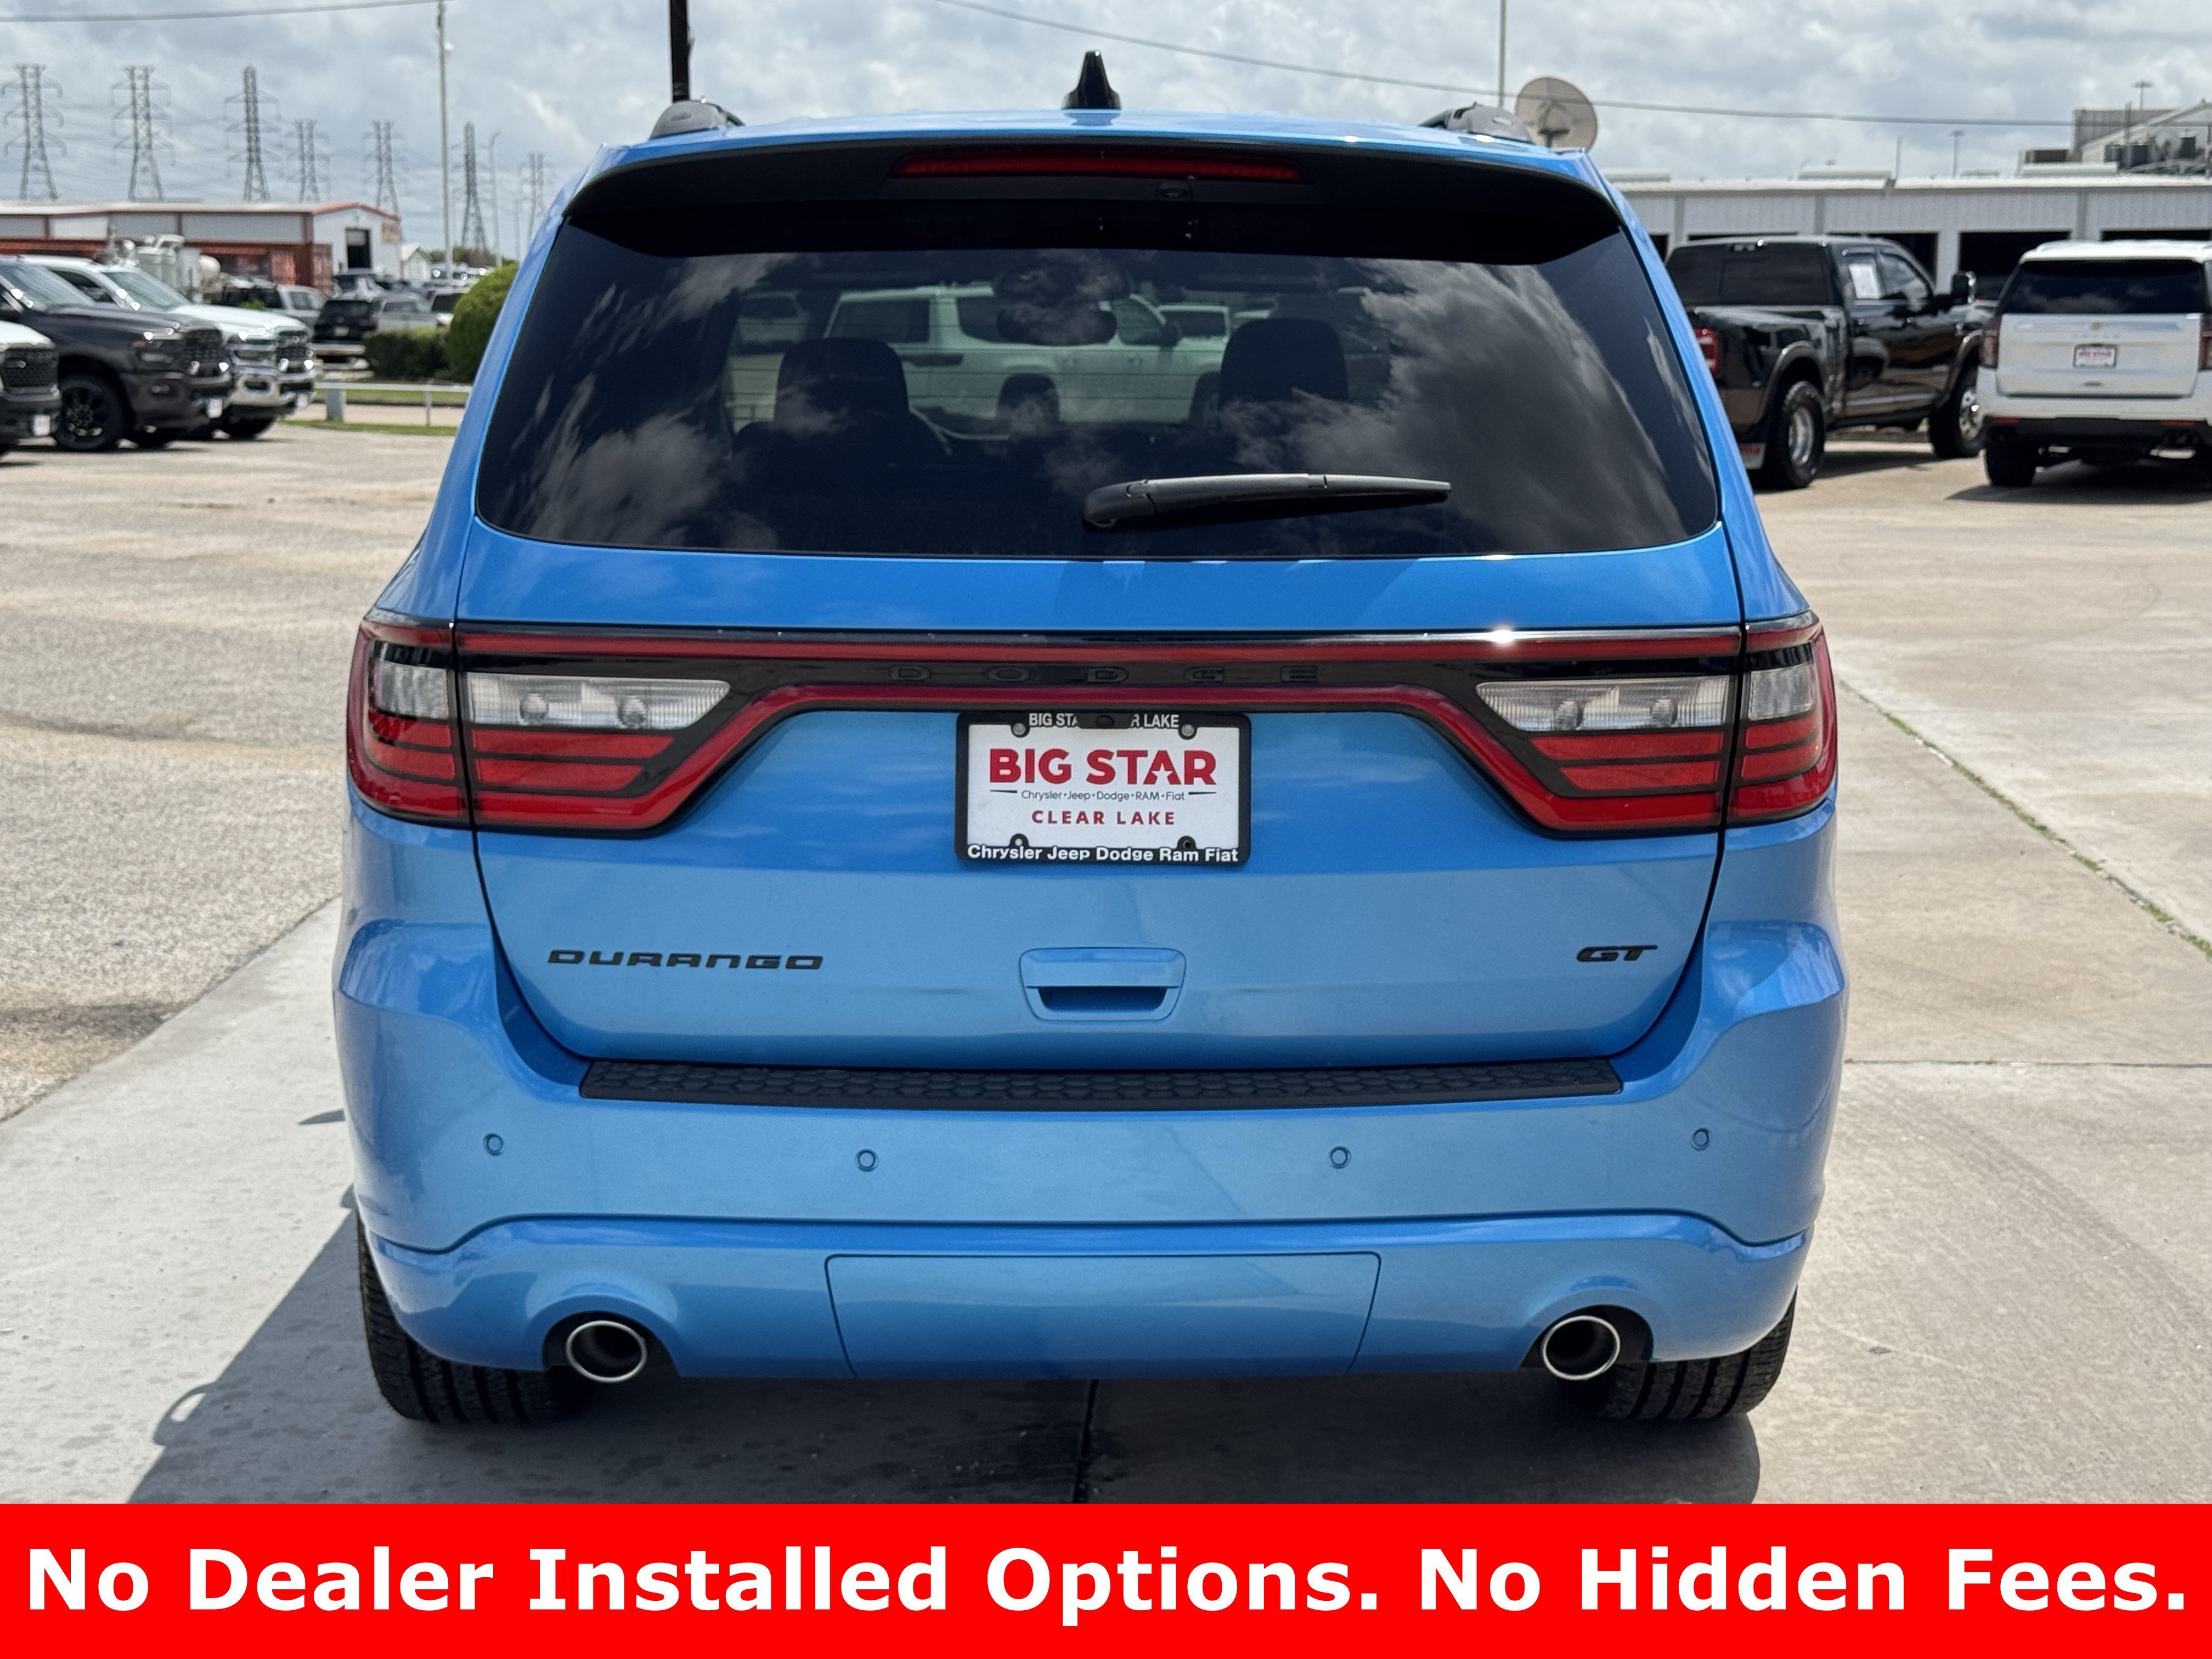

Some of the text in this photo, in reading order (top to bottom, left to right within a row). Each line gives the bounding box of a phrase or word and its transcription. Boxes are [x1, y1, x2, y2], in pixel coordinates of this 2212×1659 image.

[889, 665, 1318, 684] DODGE
[1029, 713, 1053, 726] BIG
[1056, 713, 1078, 726] STA
[1144, 713, 1180, 728] LAKE
[989, 748, 1217, 786] BIG STAR
[1031, 810, 1175, 825] CLEAR LAKE
[967, 845, 1238, 862] Chrysler Jeep Dodge Ram Fiat
[548, 949, 823, 970] DURANGO
[1577, 945, 1658, 962] GT
